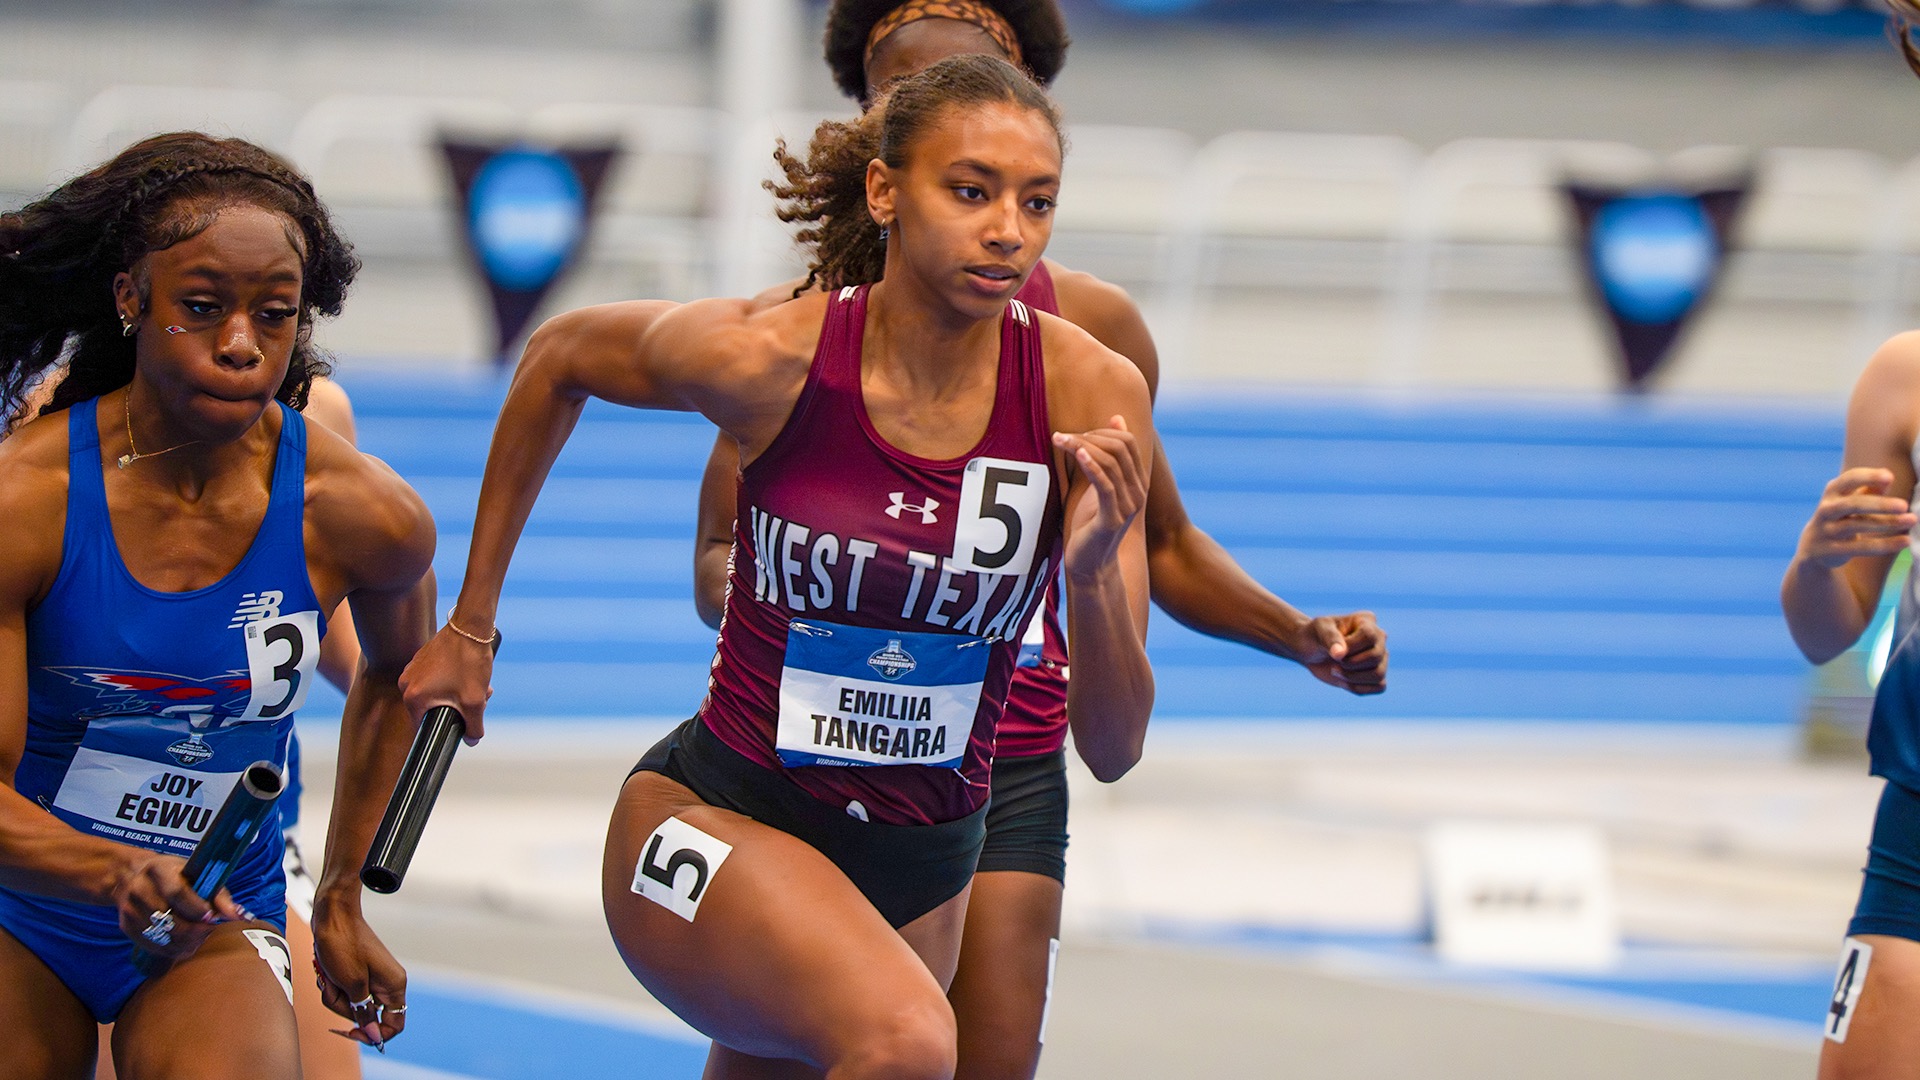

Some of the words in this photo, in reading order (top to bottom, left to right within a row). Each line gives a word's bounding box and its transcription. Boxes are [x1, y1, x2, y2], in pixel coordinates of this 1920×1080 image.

[970, 465, 1030, 569] 5
[750, 504, 879, 613] WEST
[899, 549, 1049, 643] TEXAS
[257, 622, 305, 718] 3
[838, 687, 932, 722] EMILIIA
[810, 713, 947, 759] TANGARA
[115, 792, 213, 834] EGWU
[149, 771, 204, 799] JOY
[91, 822, 126, 838] VIRGINIA
[124, 831, 152, 844] BEACH,
[152, 836, 164, 846] VA
[168, 839, 198, 852] MARCH
[641, 833, 709, 903] 5
[1830, 948, 1860, 1034] 4
